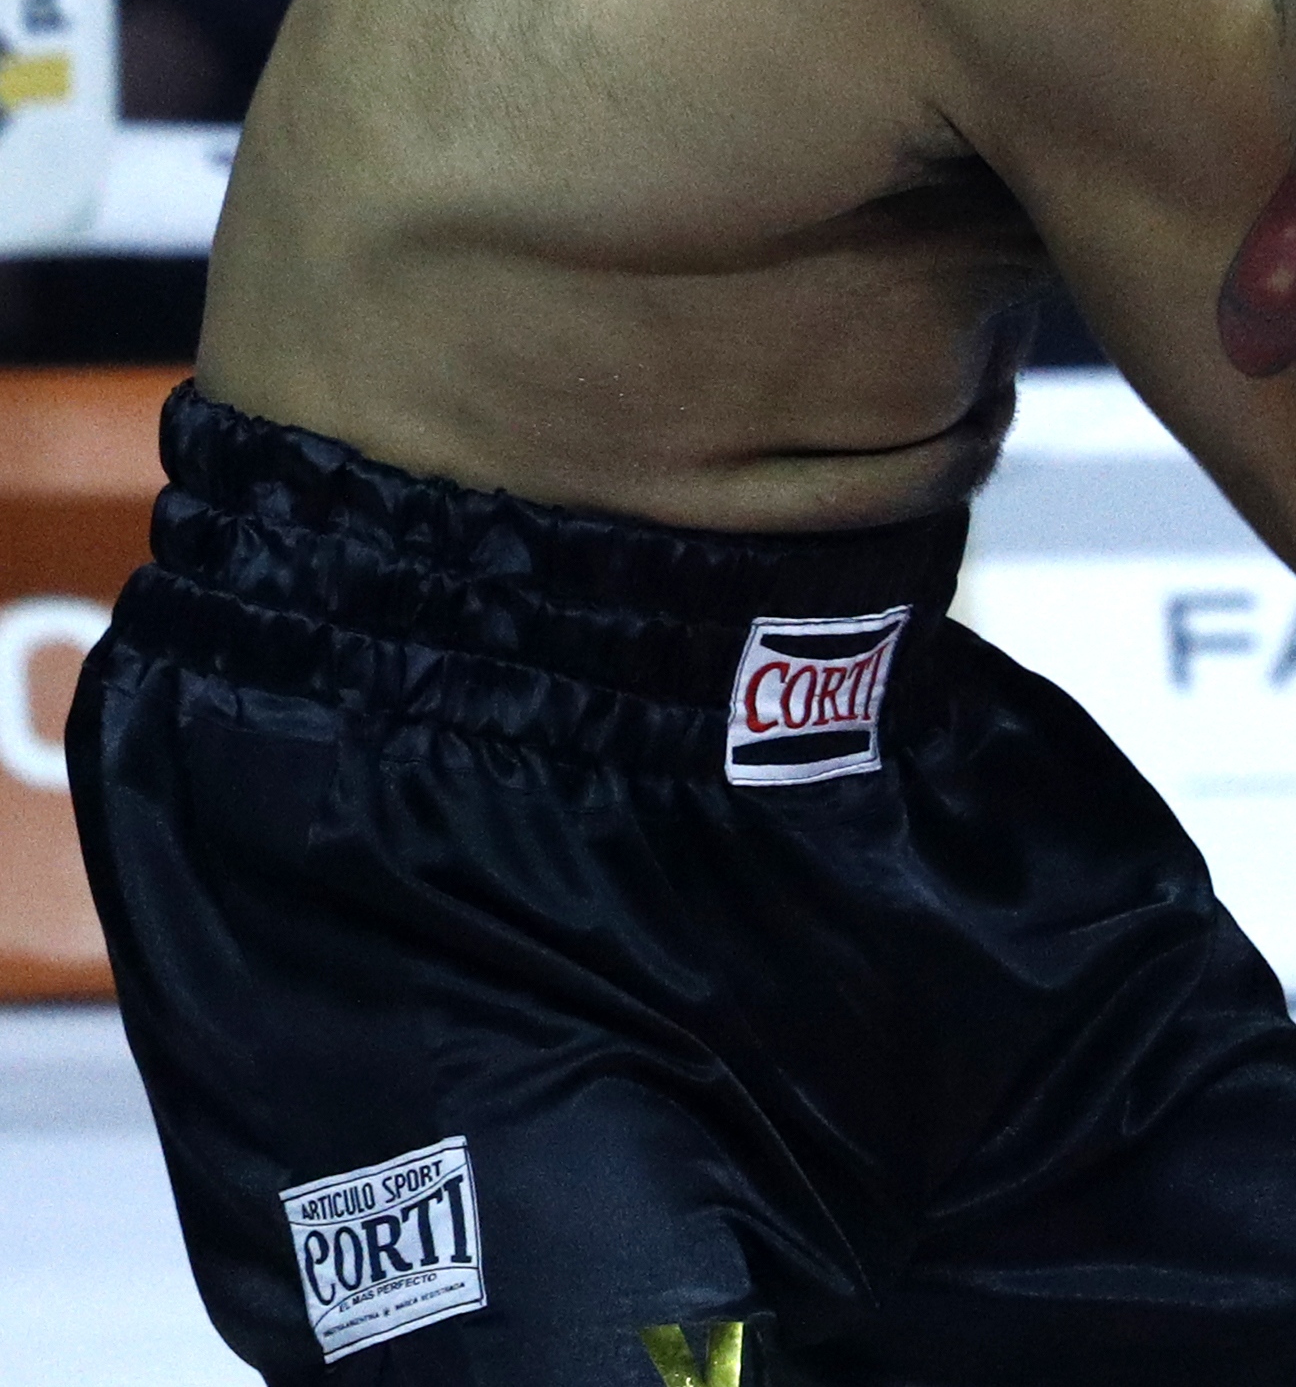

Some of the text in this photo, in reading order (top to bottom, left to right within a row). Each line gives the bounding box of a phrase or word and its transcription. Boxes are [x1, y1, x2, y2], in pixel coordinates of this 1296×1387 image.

[744, 643, 888, 734] CORTI
[301, 1160, 443, 1221] ARTICULO SPORT
[303, 1174, 473, 1306] CORTI
[377, 1273, 437, 1297] PERFECTO
